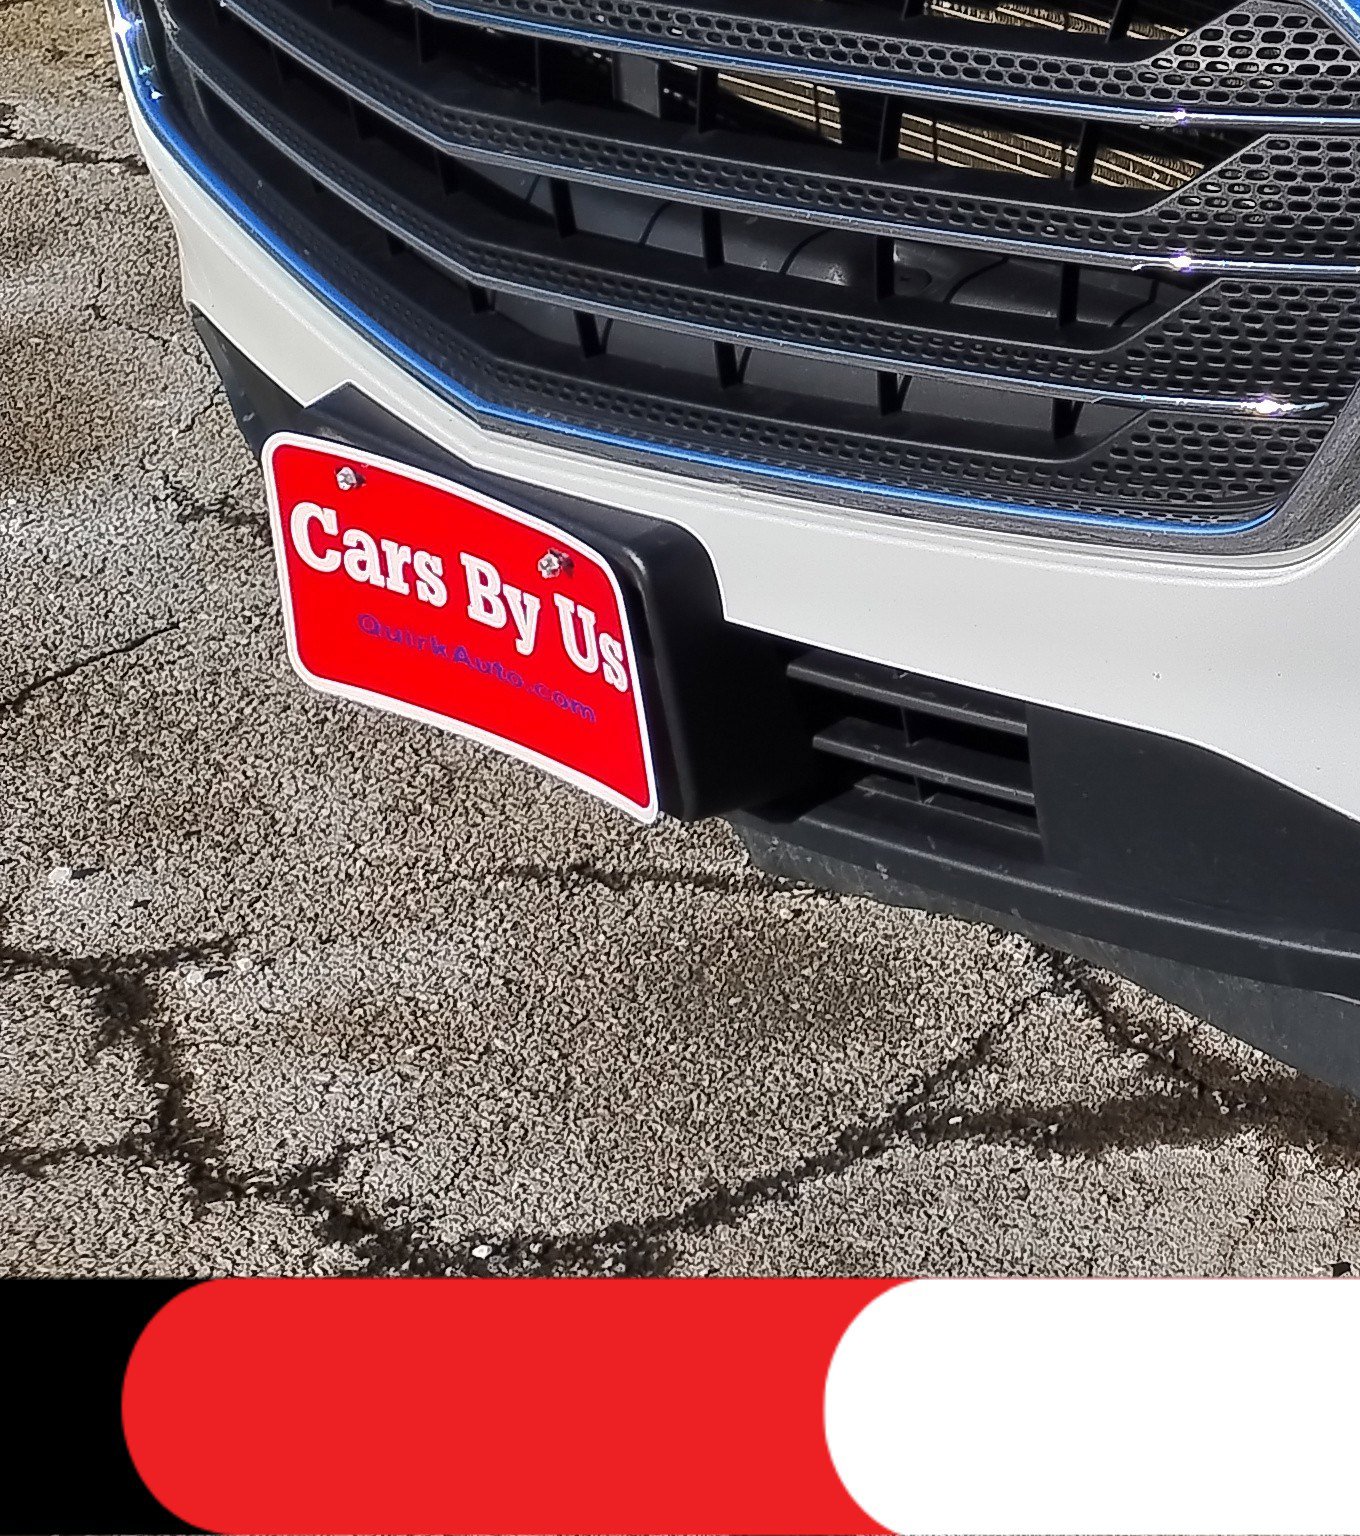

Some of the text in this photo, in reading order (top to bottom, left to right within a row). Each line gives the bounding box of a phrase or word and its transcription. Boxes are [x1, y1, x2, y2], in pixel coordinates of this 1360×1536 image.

[289, 501, 630, 694] Cars By Us
